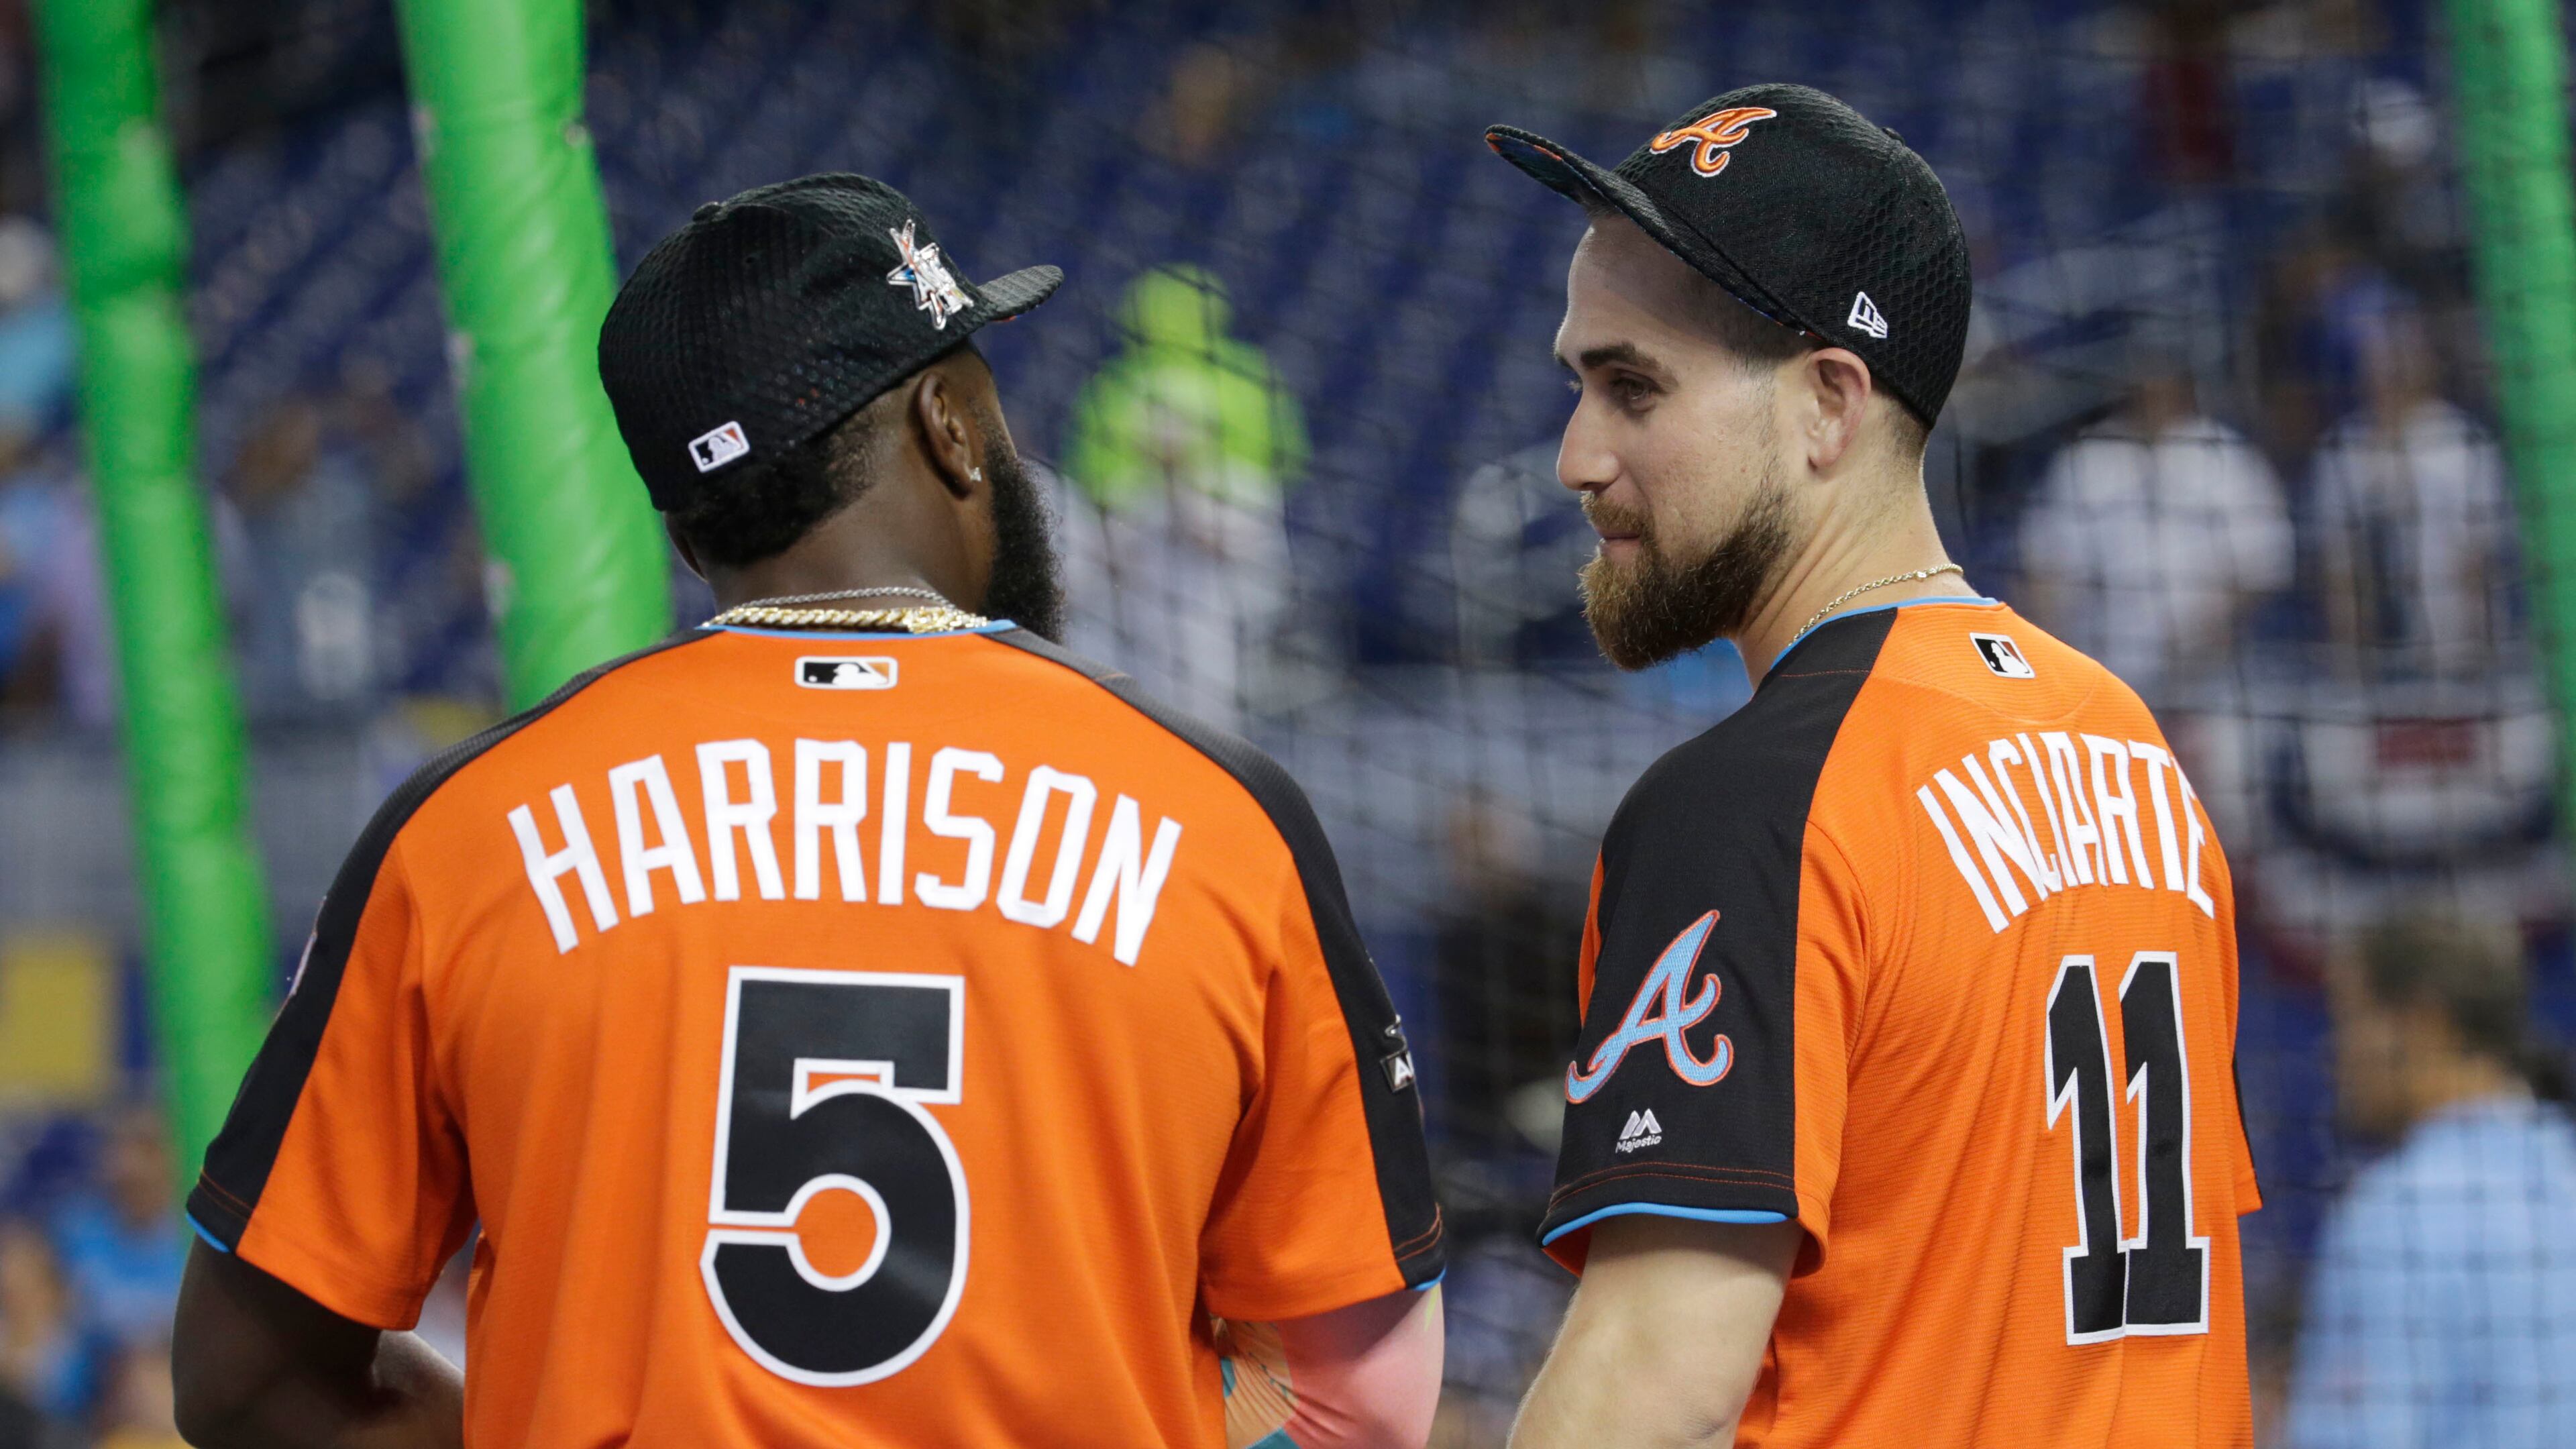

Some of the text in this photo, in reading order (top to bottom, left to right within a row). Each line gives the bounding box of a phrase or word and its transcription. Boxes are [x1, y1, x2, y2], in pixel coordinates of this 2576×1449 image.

[506, 738, 1182, 967] HARRISON
[1917, 731, 2214, 934] INCIARTE
[1565, 909, 1734, 1105] A
[699, 965, 970, 1387] 5
[1615, 1134, 1662, 1153] Majestic
[2045, 951, 2210, 1346] 11
